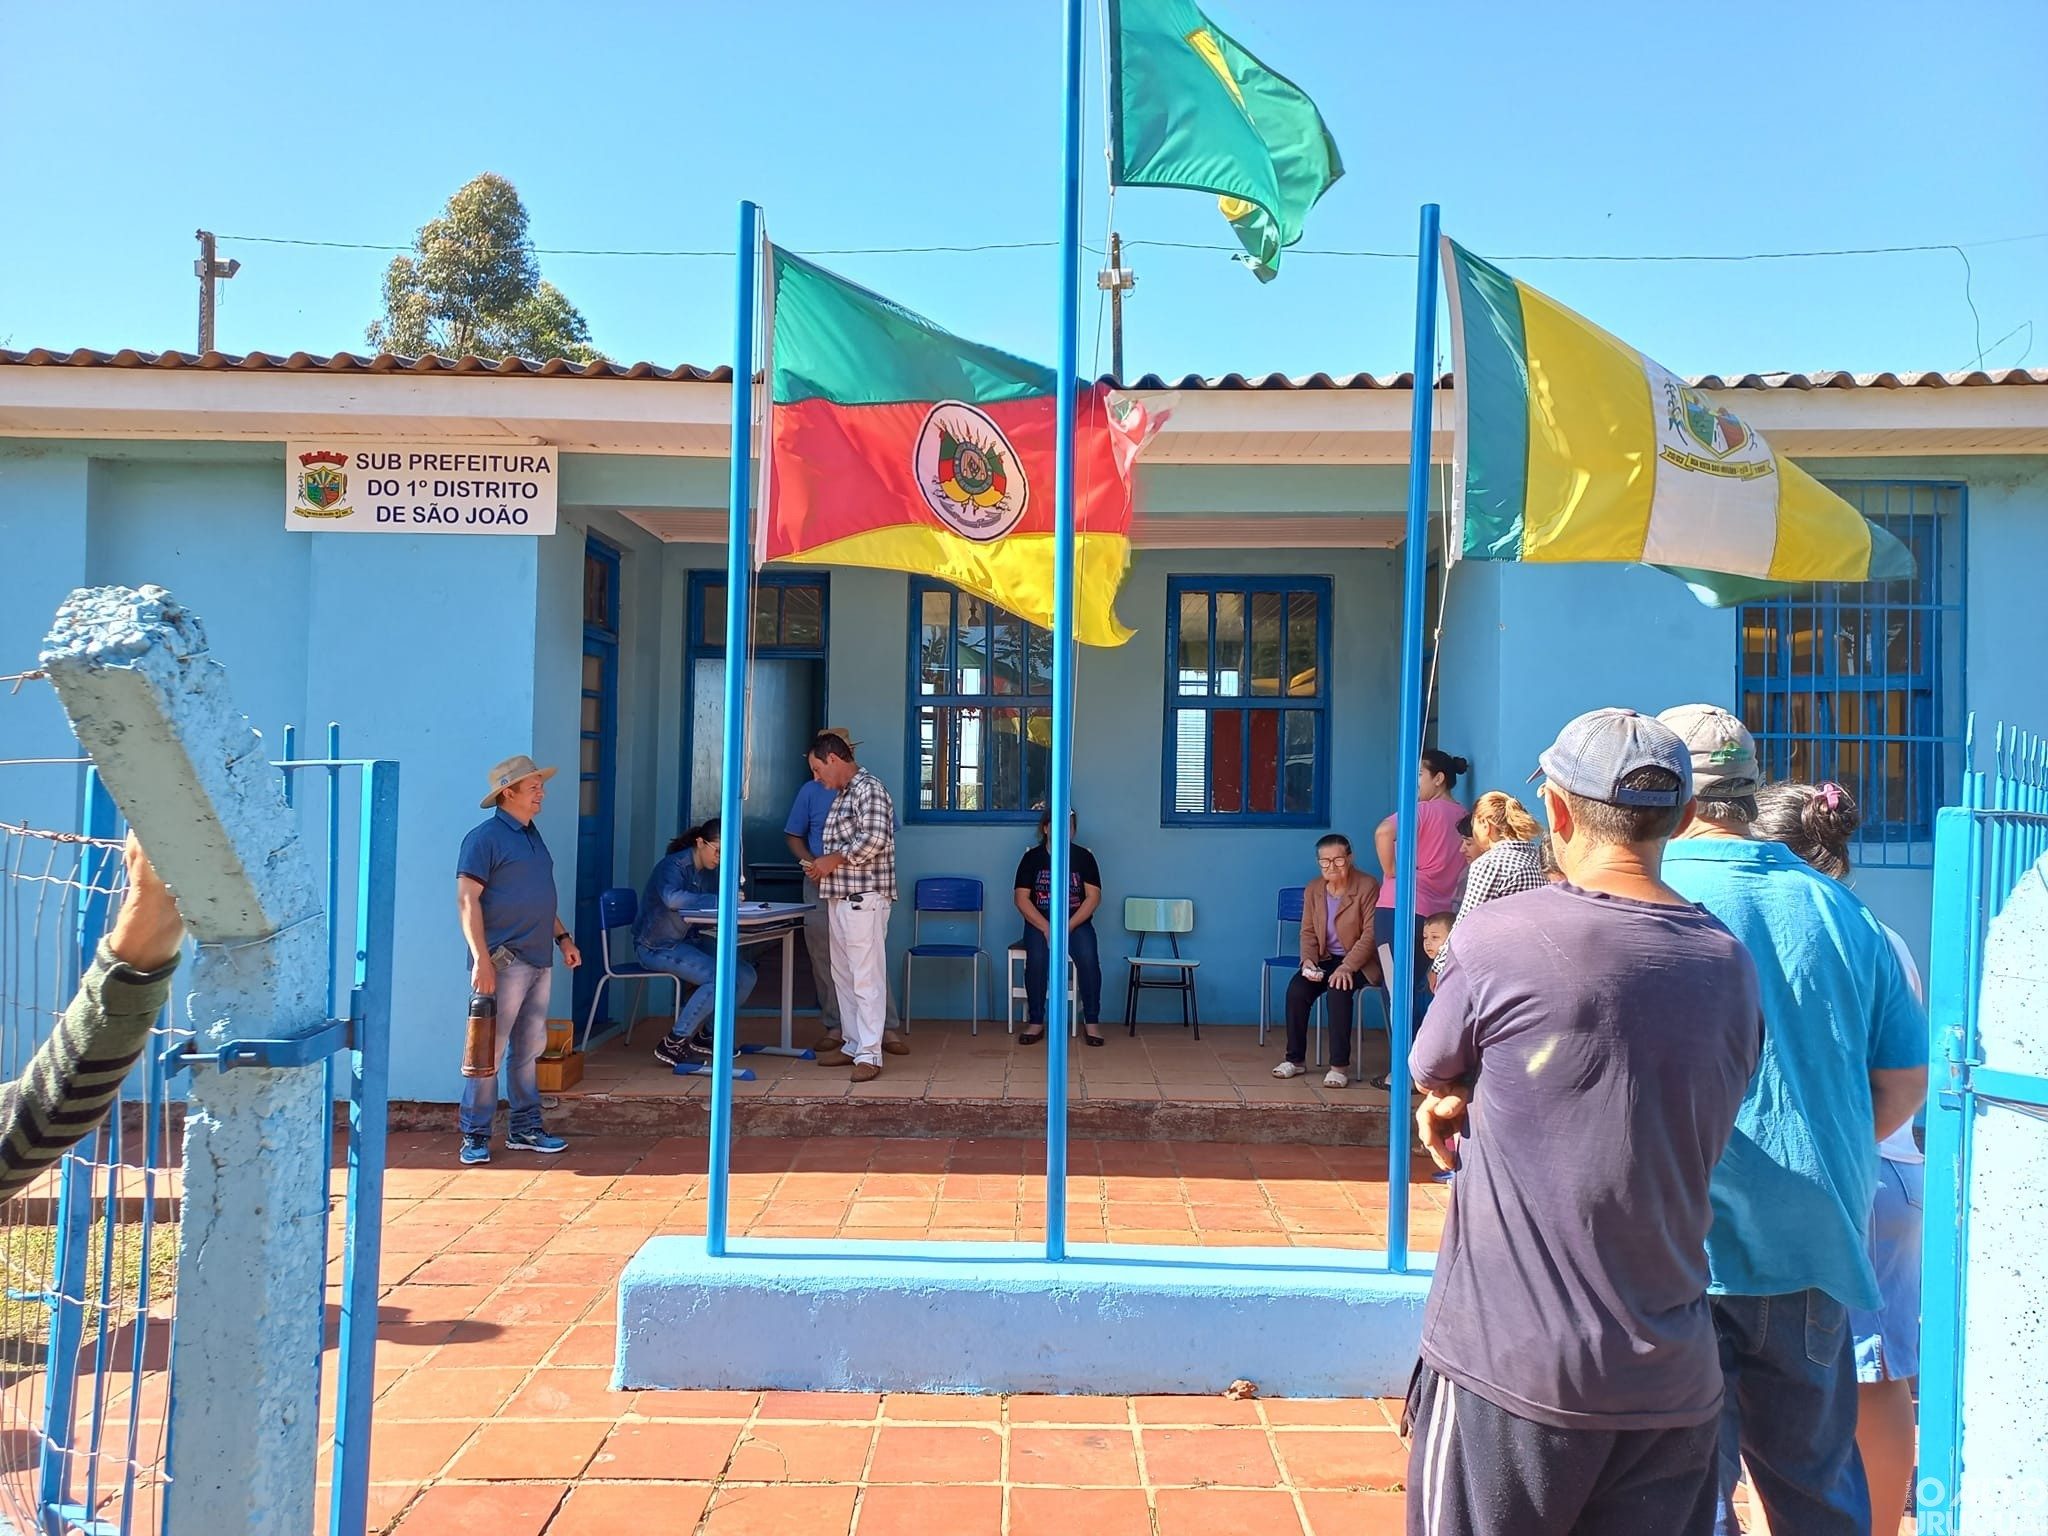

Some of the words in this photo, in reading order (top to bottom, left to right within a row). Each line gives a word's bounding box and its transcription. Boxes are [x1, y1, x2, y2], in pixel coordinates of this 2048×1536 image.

[356, 453, 401, 470] SUB
[409, 454, 551, 473] PREFEITURA
[368, 480, 399, 496] DO
[434, 481, 538, 499] DISTRITO
[376, 506, 406, 522] DE
[413, 503, 458, 523] SÃO
[465, 504, 528, 525] JOÃO
